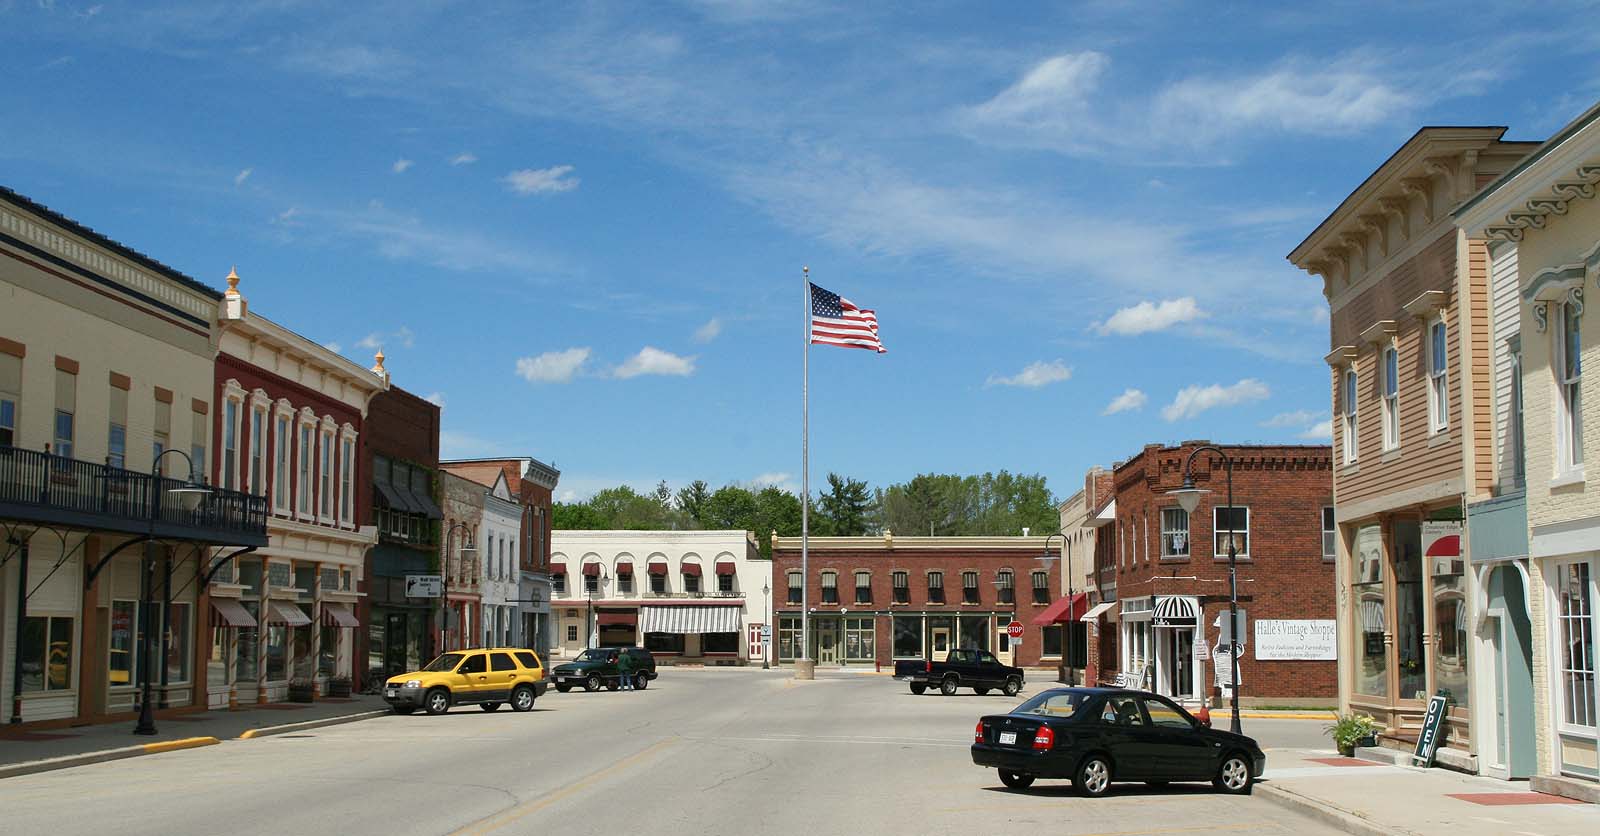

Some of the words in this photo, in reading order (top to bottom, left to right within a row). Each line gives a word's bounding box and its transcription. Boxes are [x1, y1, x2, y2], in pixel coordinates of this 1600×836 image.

[1257, 620, 1281, 635] Halle's
[1281, 621, 1308, 641] Vintage
[1310, 621, 1335, 641] Shoppe
[1421, 700, 1438, 757] OPEN
